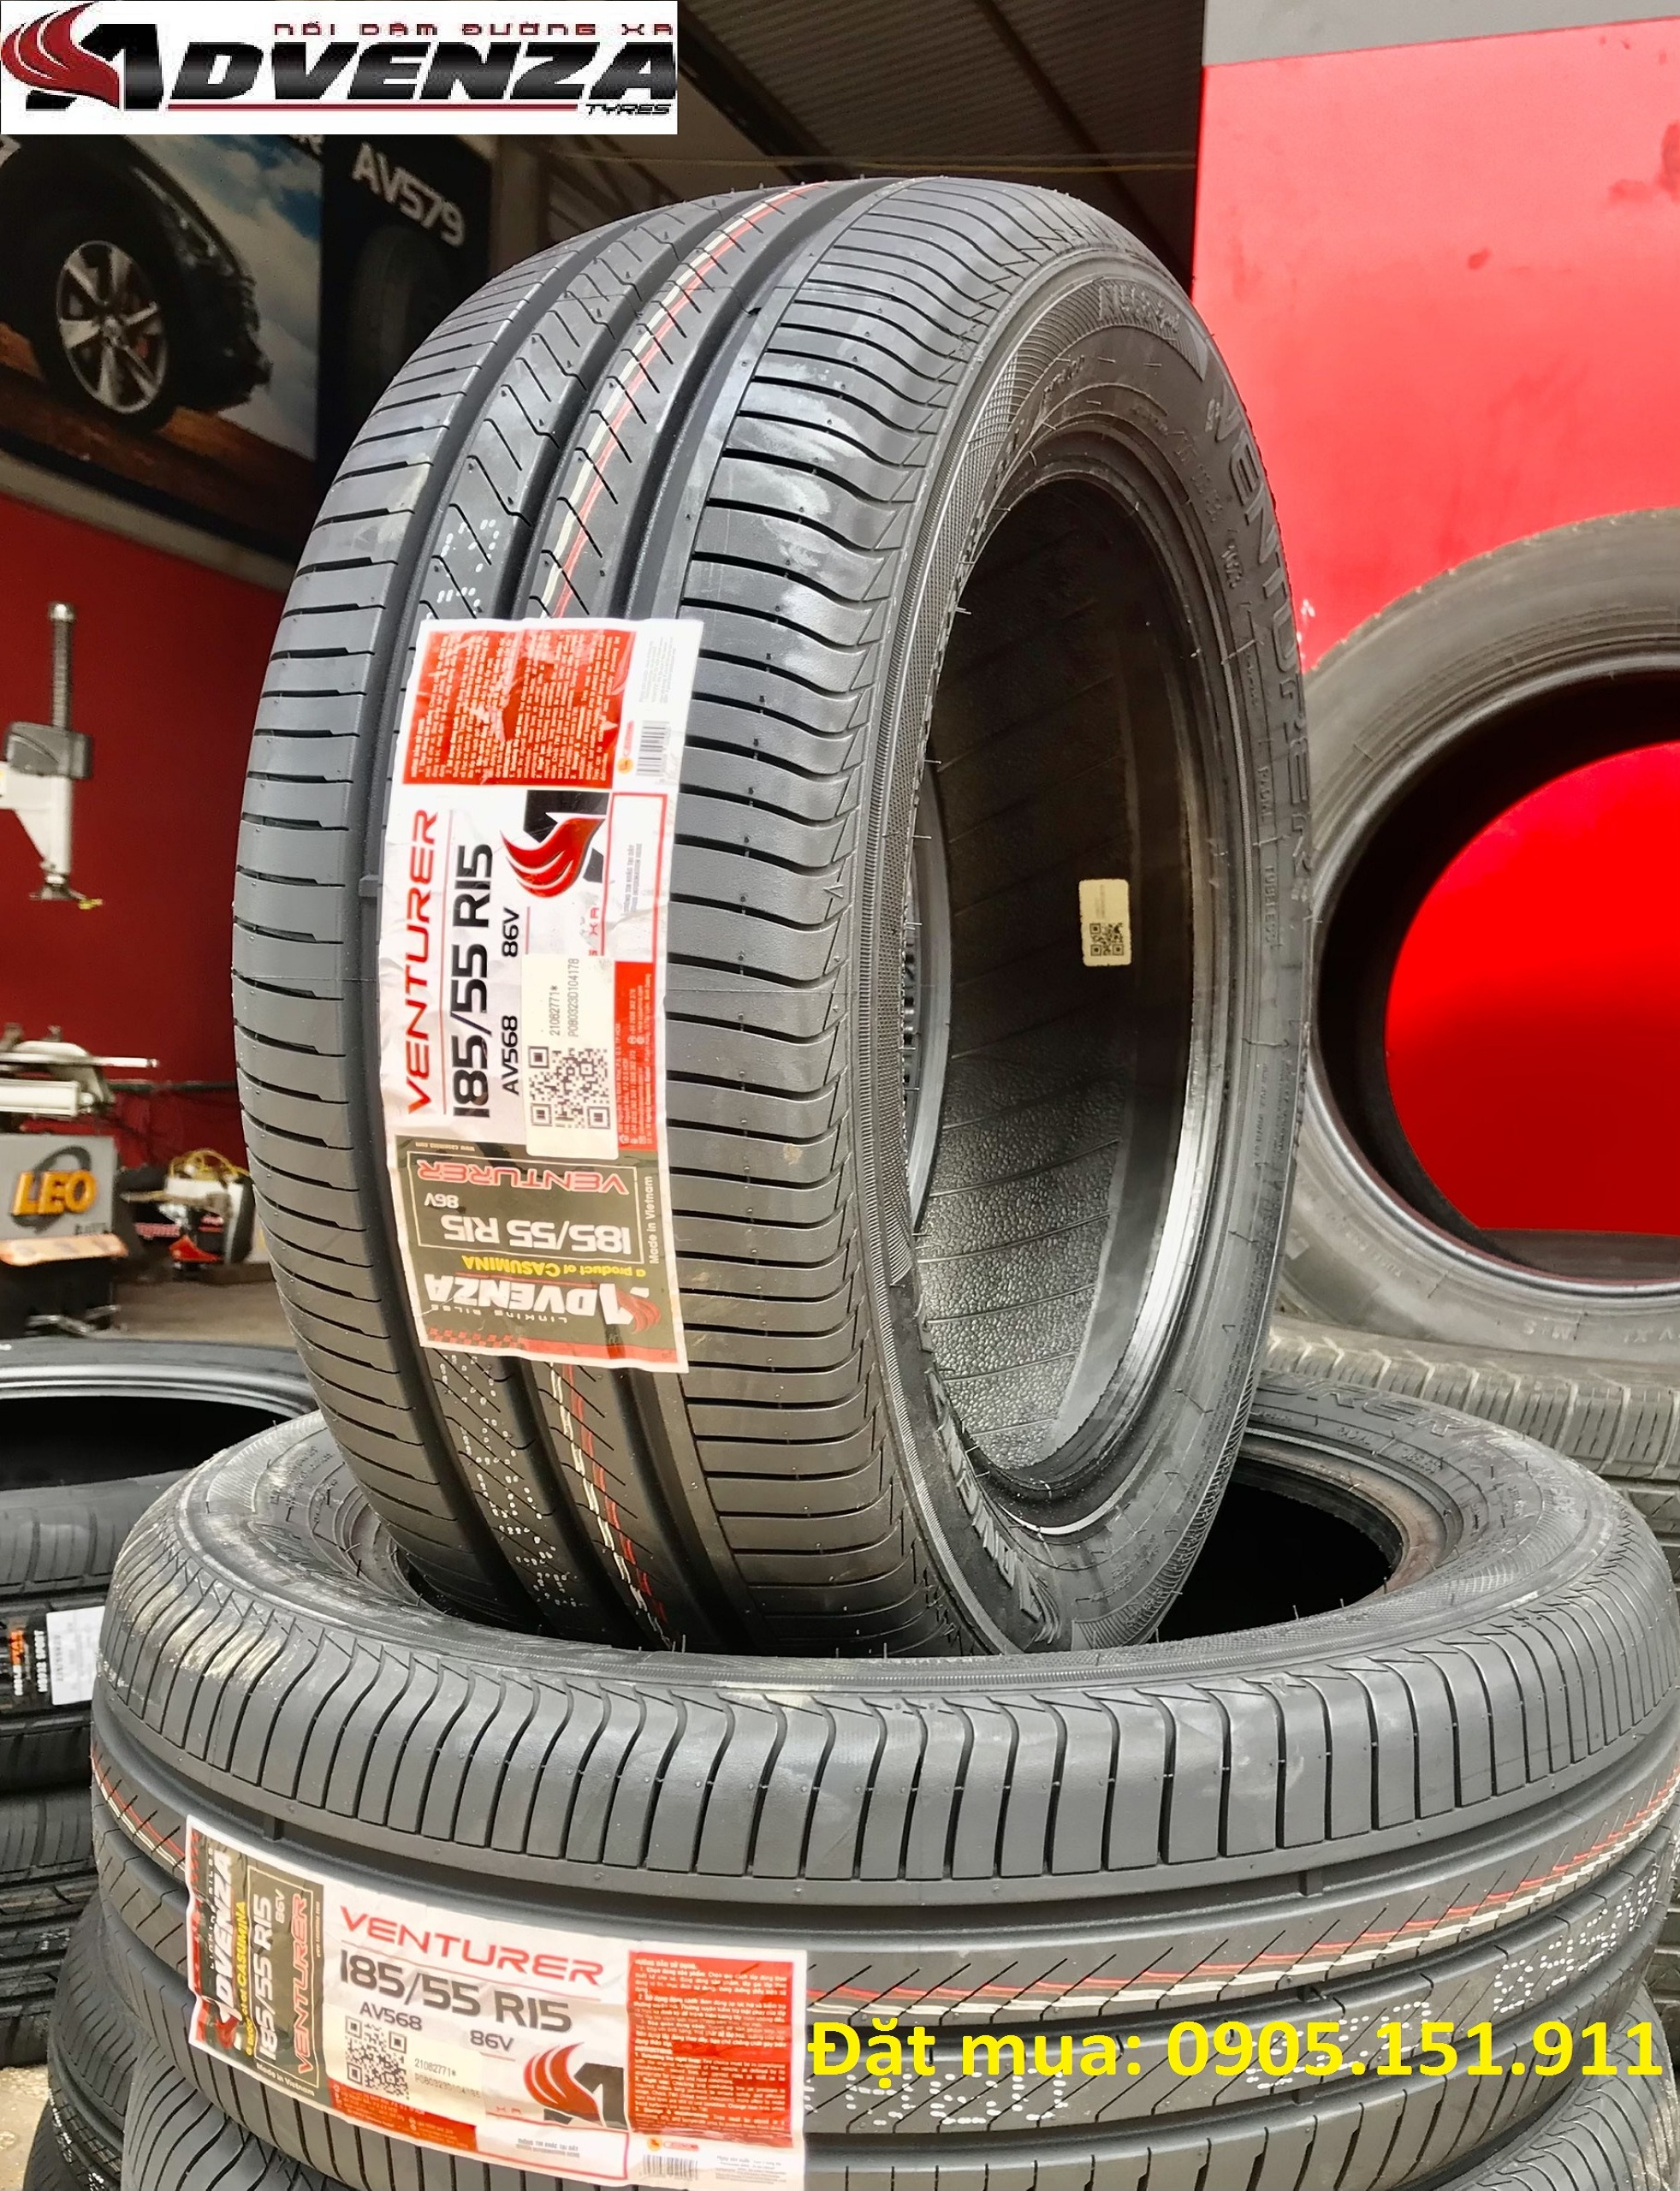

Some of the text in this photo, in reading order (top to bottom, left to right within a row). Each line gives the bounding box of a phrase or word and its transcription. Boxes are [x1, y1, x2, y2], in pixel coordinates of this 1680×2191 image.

[502, 906, 519, 957] 86V
[405, 810, 437, 1114] VENTURER
[450, 844, 492, 1119] 185/55 R15
[502, 1015, 519, 1096] AV568
[12, 1170, 98, 1217] LEO
[416, 1160, 629, 1195] VENTURER
[424, 1192, 459, 1208] 86V
[441, 1214, 632, 1254] 185/55 R15
[644, 1175, 661, 1264] Made in Vietnam
[462, 1256, 646, 1277] a product of CASUMINA
[424, 1274, 649, 1325] ADVENZA
[274, 1888, 286, 1924] 86V
[235, 1902, 248, 1991] CASUMINA
[340, 1905, 603, 1986] VENTURER
[253, 1894, 277, 2061] 185/55 R15
[292, 1892, 314, 2074] VENTURER
[341, 1950, 482, 2019] 185/55
[494, 1990, 573, 2033] R15
[359, 2001, 423, 2031] AV568
[470, 2030, 513, 2051] 86V
